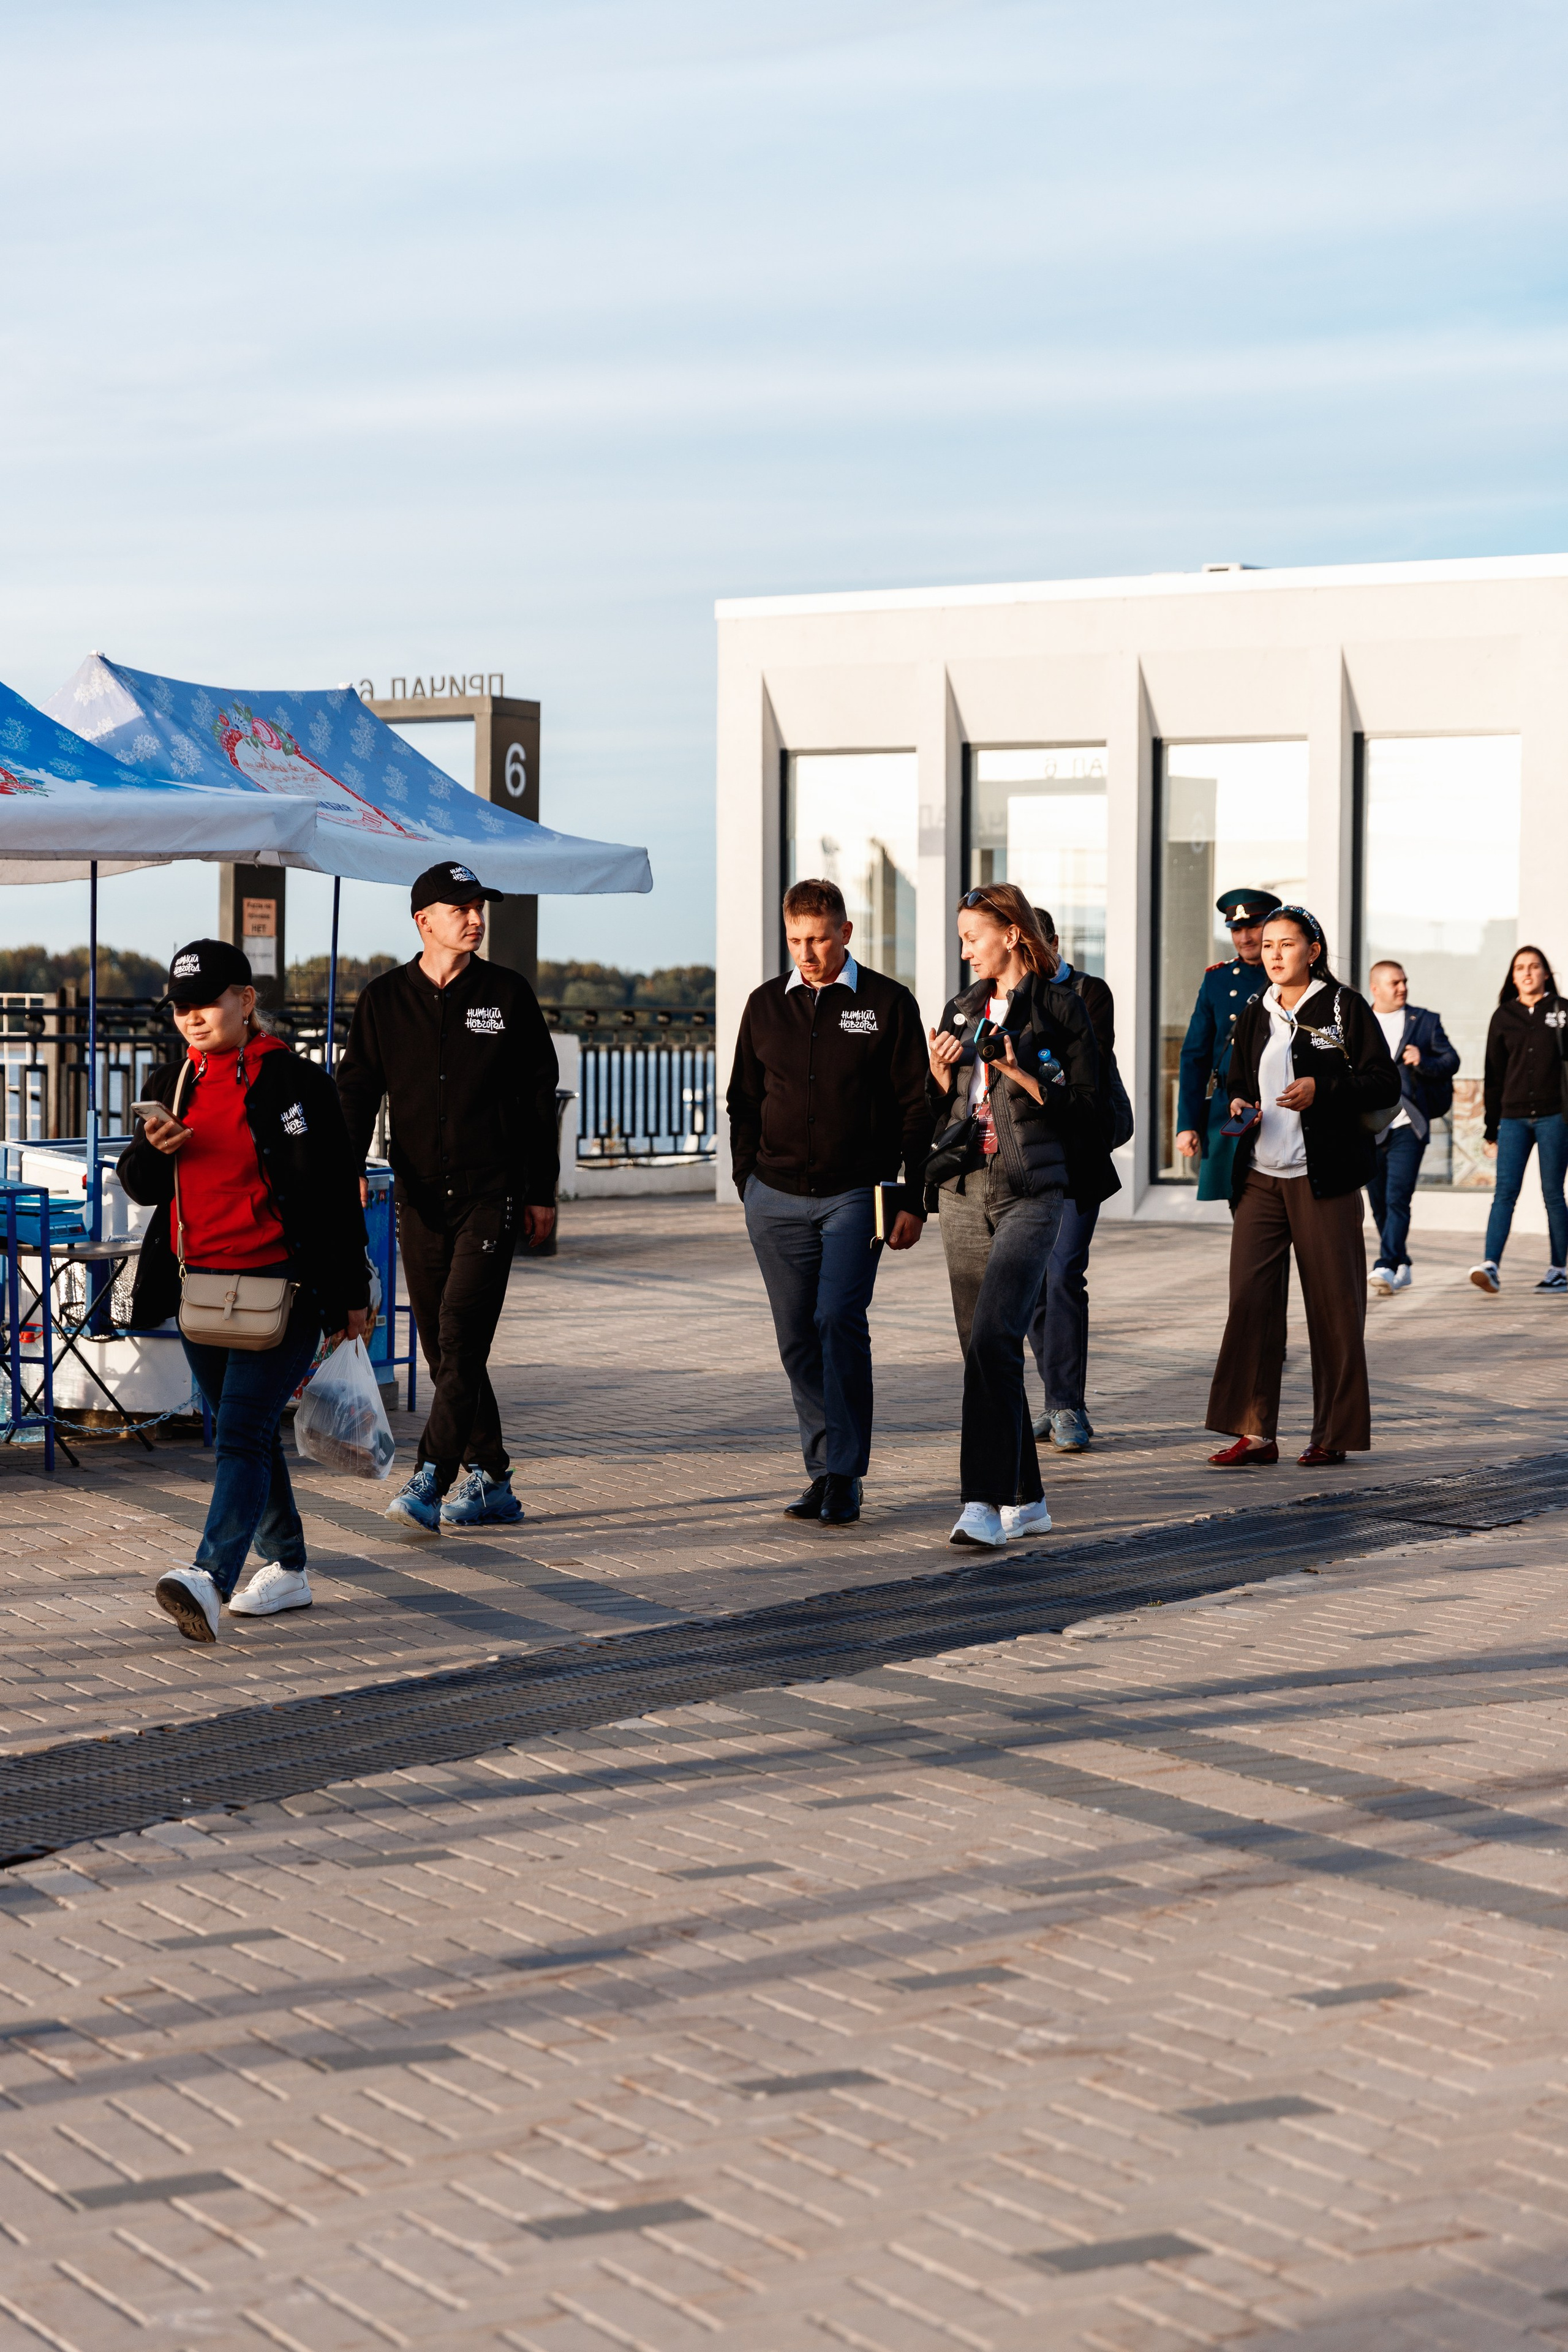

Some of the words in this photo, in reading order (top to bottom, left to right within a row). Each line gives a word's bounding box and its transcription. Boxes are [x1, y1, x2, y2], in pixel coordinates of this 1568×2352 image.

[505, 742, 526, 797] 6
[467, 1008, 502, 1019] НИЖНИЙ
[841, 1009, 875, 1021] НИЖНИЙ
[465, 1017, 505, 1031] НОВГОРОД
[838, 1019, 878, 1030] НОВГОРОД
[281, 1102, 303, 1122] НИЖН
[284, 1117, 306, 1134] НОВГ
